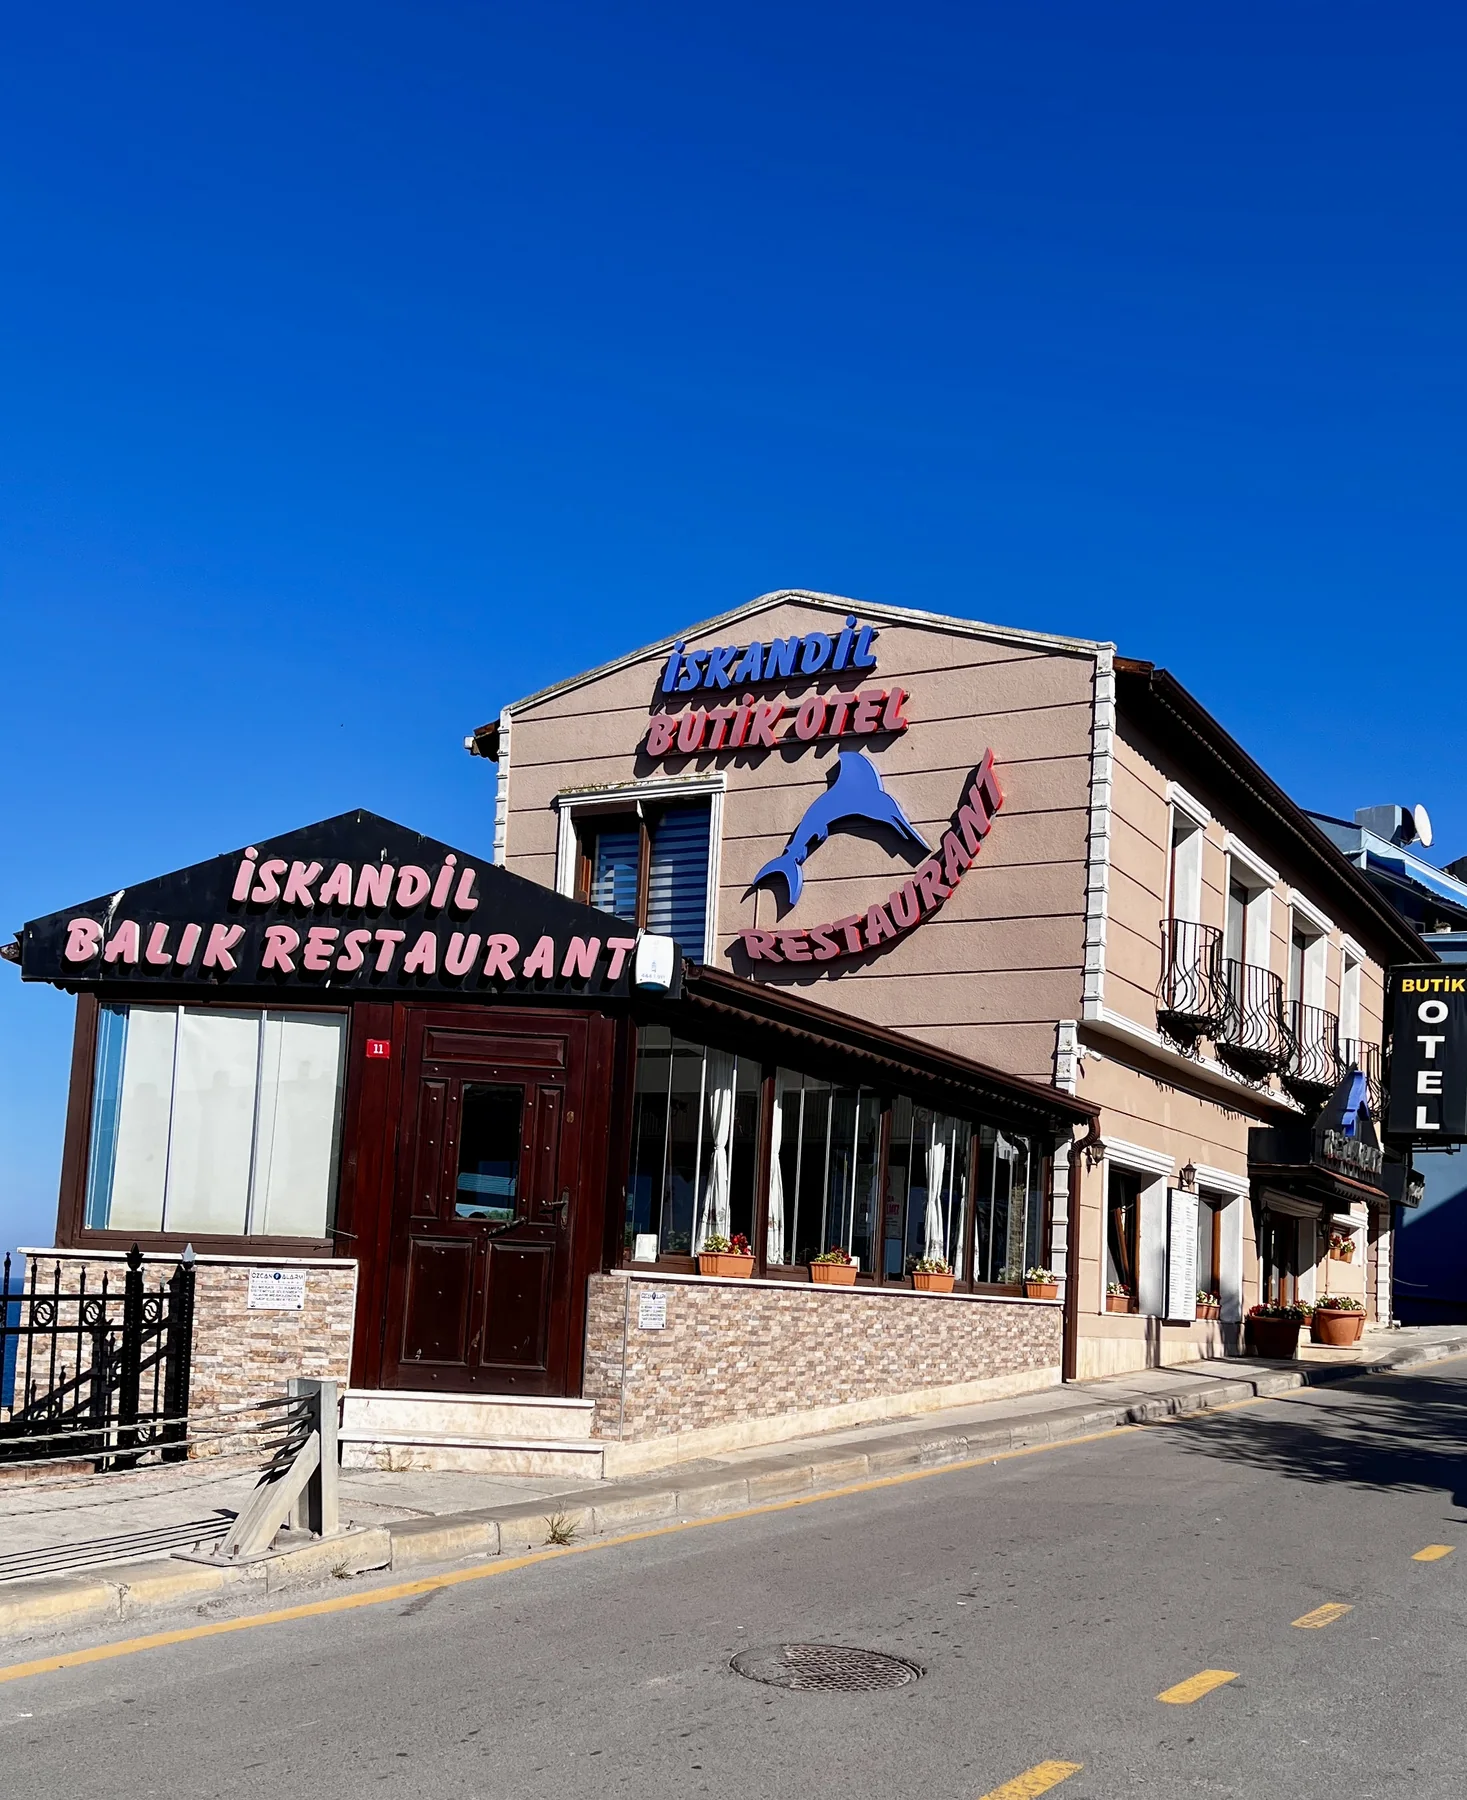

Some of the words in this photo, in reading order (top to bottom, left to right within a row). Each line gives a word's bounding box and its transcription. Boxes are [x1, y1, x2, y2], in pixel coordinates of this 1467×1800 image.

[661, 614, 877, 692] İSKANDİL
[646, 693, 786, 756] BUTİK
[795, 687, 909, 741] OTEL
[232, 846, 479, 911] İSKANDİL
[738, 747, 1004, 962] RESTAURANT
[64, 917, 246, 971] BALIK
[261, 925, 636, 981] RESTAURANT
[1402, 976, 1466, 992] BUTİK
[373, 1043, 383, 1054] 11
[1416, 1000, 1449, 1130] OTEL
